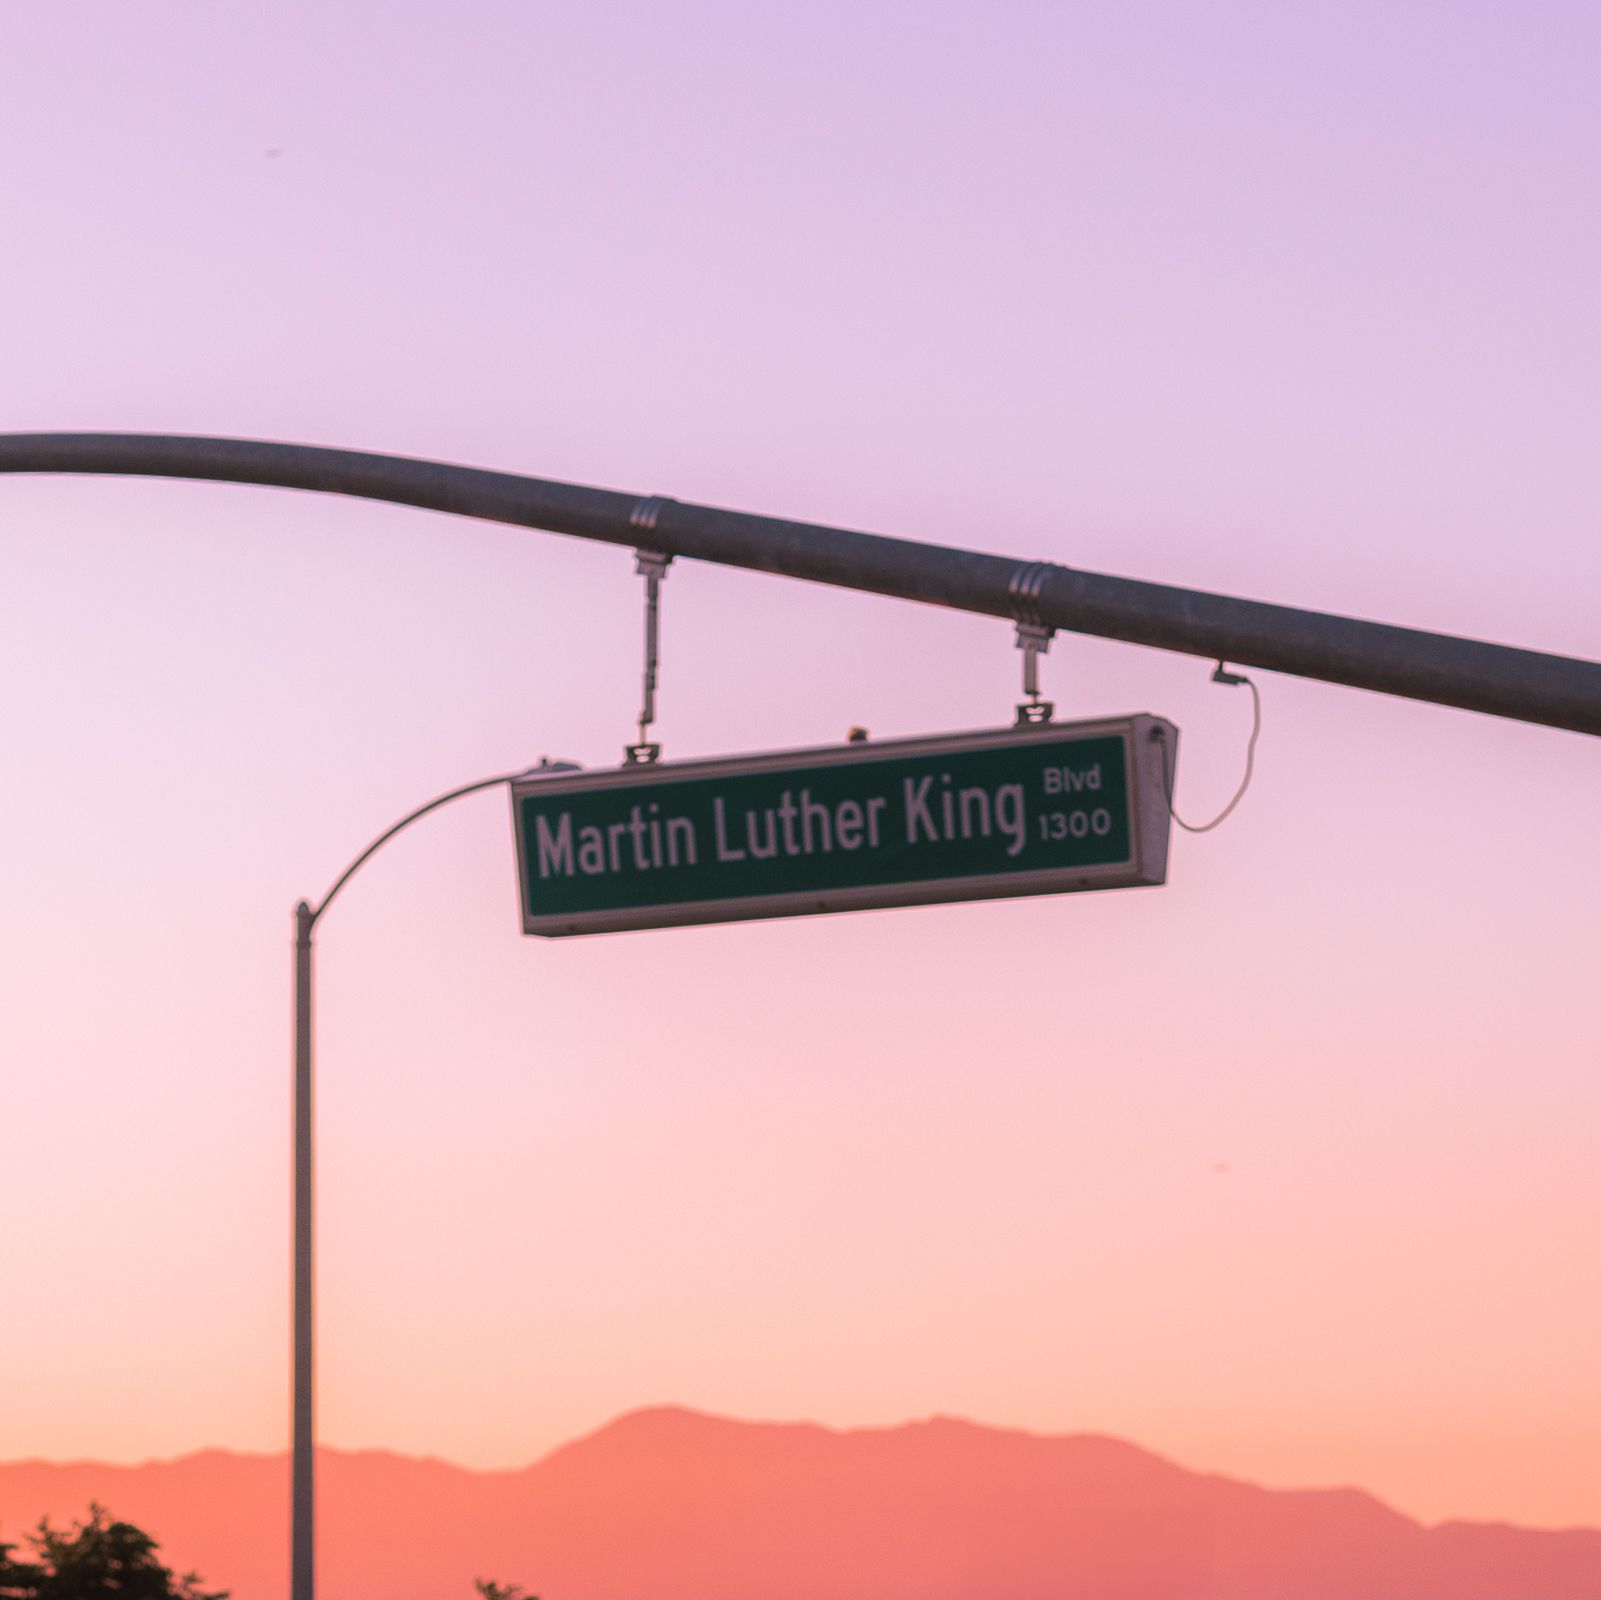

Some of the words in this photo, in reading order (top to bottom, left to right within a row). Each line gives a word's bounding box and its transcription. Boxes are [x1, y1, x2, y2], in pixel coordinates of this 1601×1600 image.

[1043, 763, 1102, 795] Blvd
[536, 803, 698, 879] Martin
[713, 788, 886, 862] Luther
[903, 773, 1028, 856] King
[1038, 807, 1111, 841] 1300
